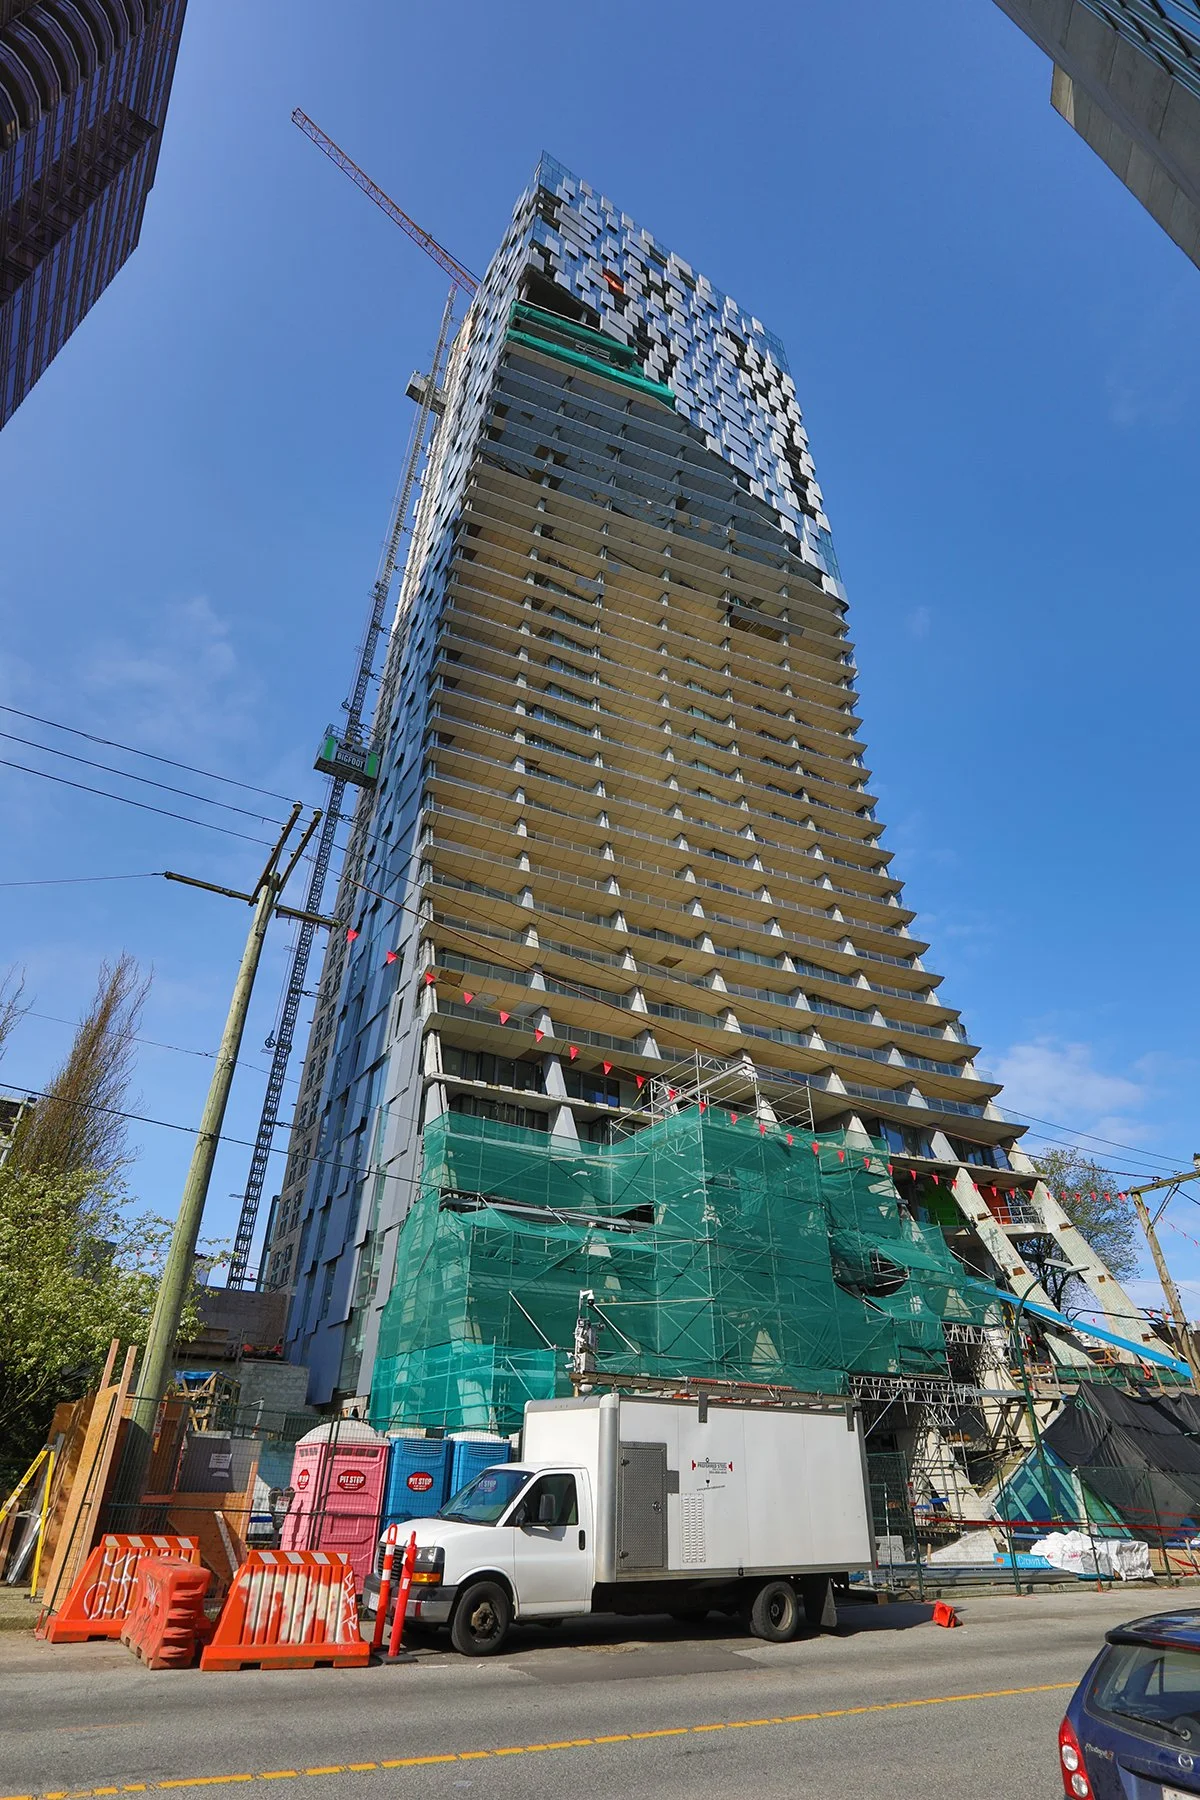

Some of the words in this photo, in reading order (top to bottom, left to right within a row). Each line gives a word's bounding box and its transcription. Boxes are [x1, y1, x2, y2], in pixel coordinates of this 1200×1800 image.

[337, 752, 363, 768] BIGFOOT
[339, 1475, 349, 1483] PIT
[349, 1475, 365, 1484] STOP
[408, 1477, 418, 1485] PIT
[418, 1477, 432, 1485] STOP
[1017, 1555, 1040, 1566] Crown
